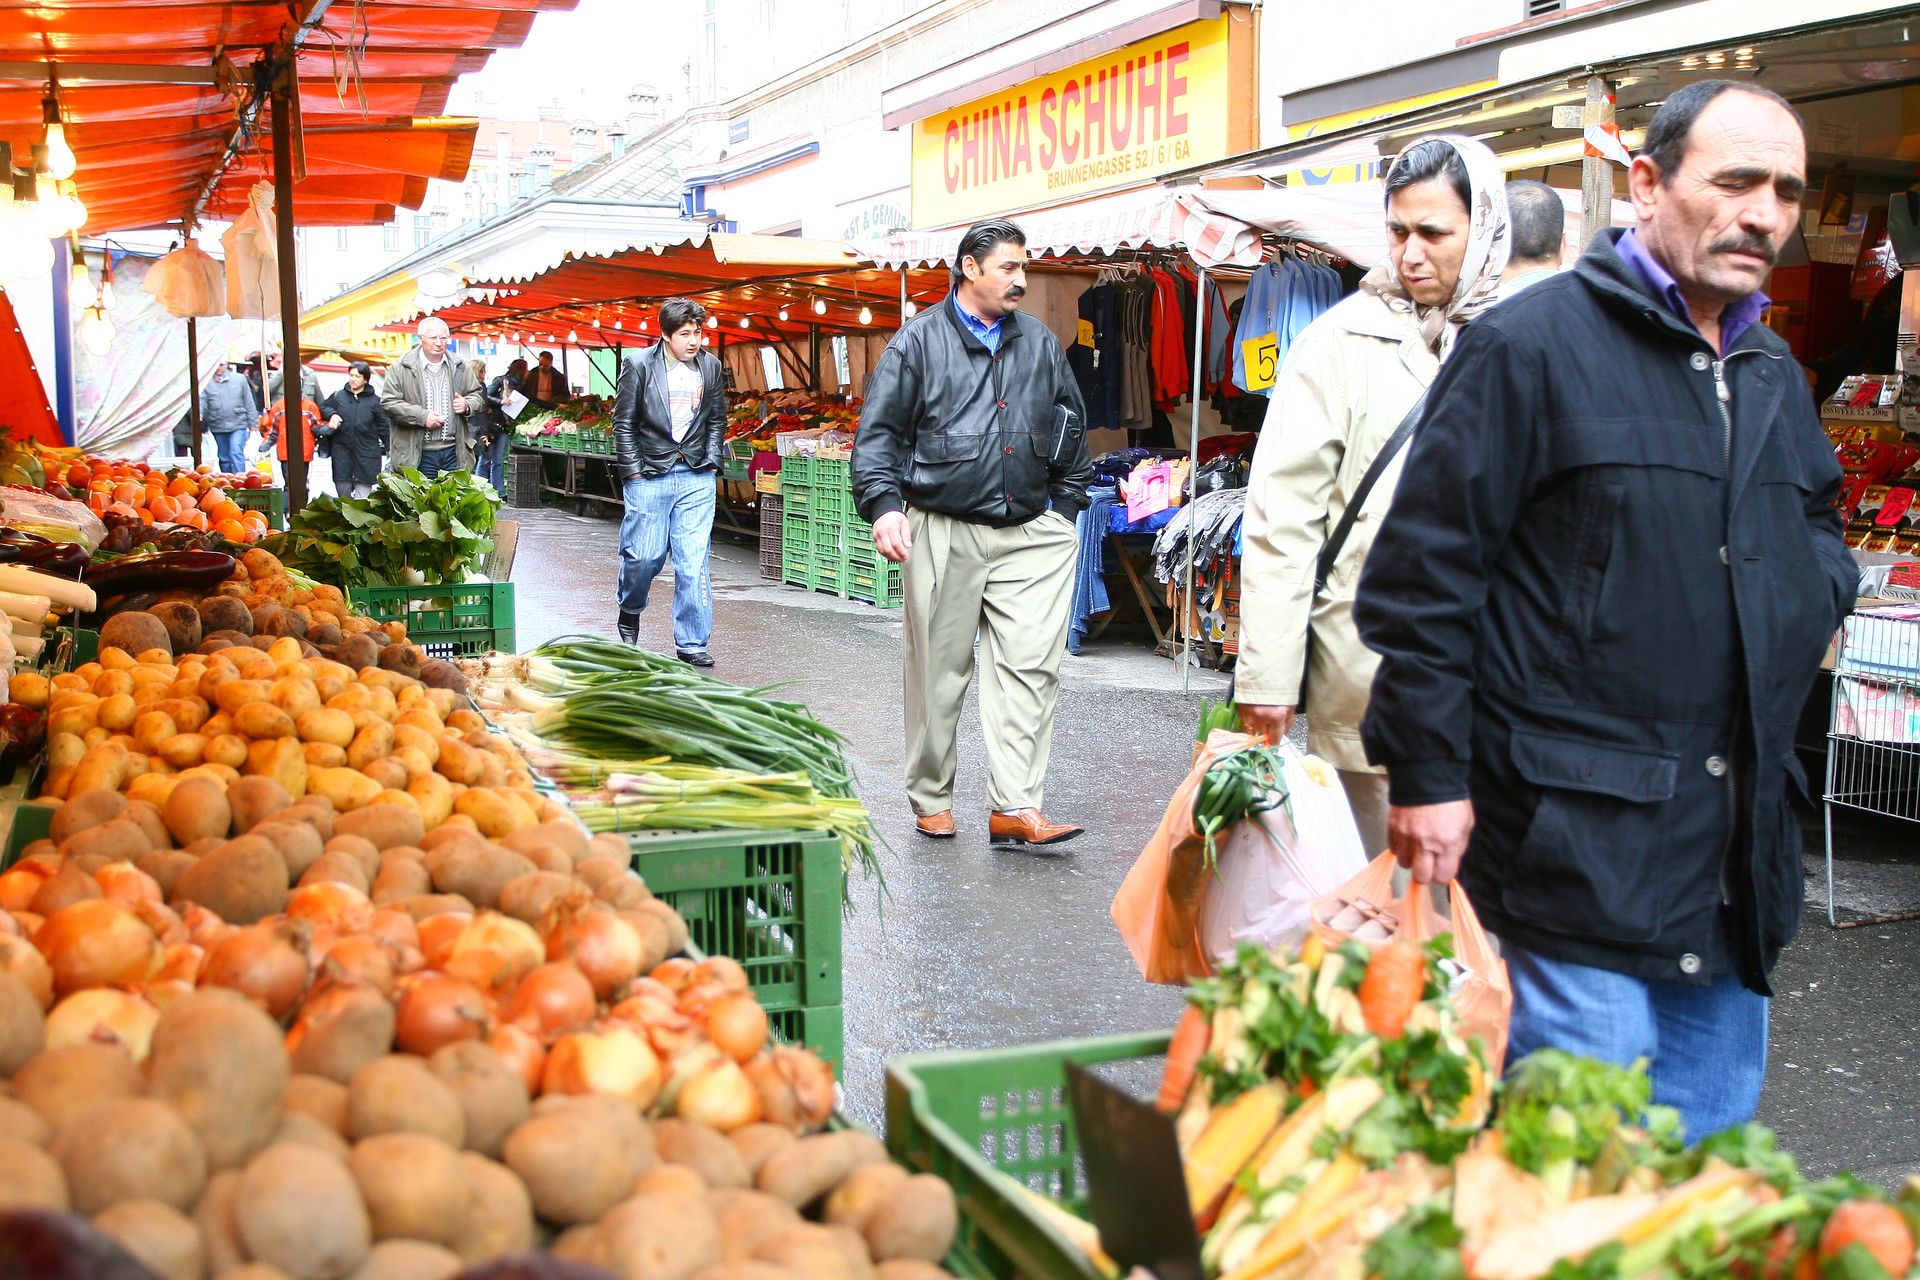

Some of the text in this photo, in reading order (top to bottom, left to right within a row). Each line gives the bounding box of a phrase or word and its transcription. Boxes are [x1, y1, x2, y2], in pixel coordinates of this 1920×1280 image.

[944, 96, 1032, 194] CHINA
[1039, 41, 1189, 171] SCHUHE
[1047, 153, 1131, 189] BRUNNENGASSE
[1135, 150, 1148, 168] 52
[1157, 145, 1165, 164] 6
[1174, 139, 1190, 161] 6A
[863, 210, 870, 232] &
[872, 200, 908, 229] GEMÜS
[1259, 344, 1277, 382] 5
[1858, 408, 1865, 416] 12
[1872, 408, 1888, 417] 200g
